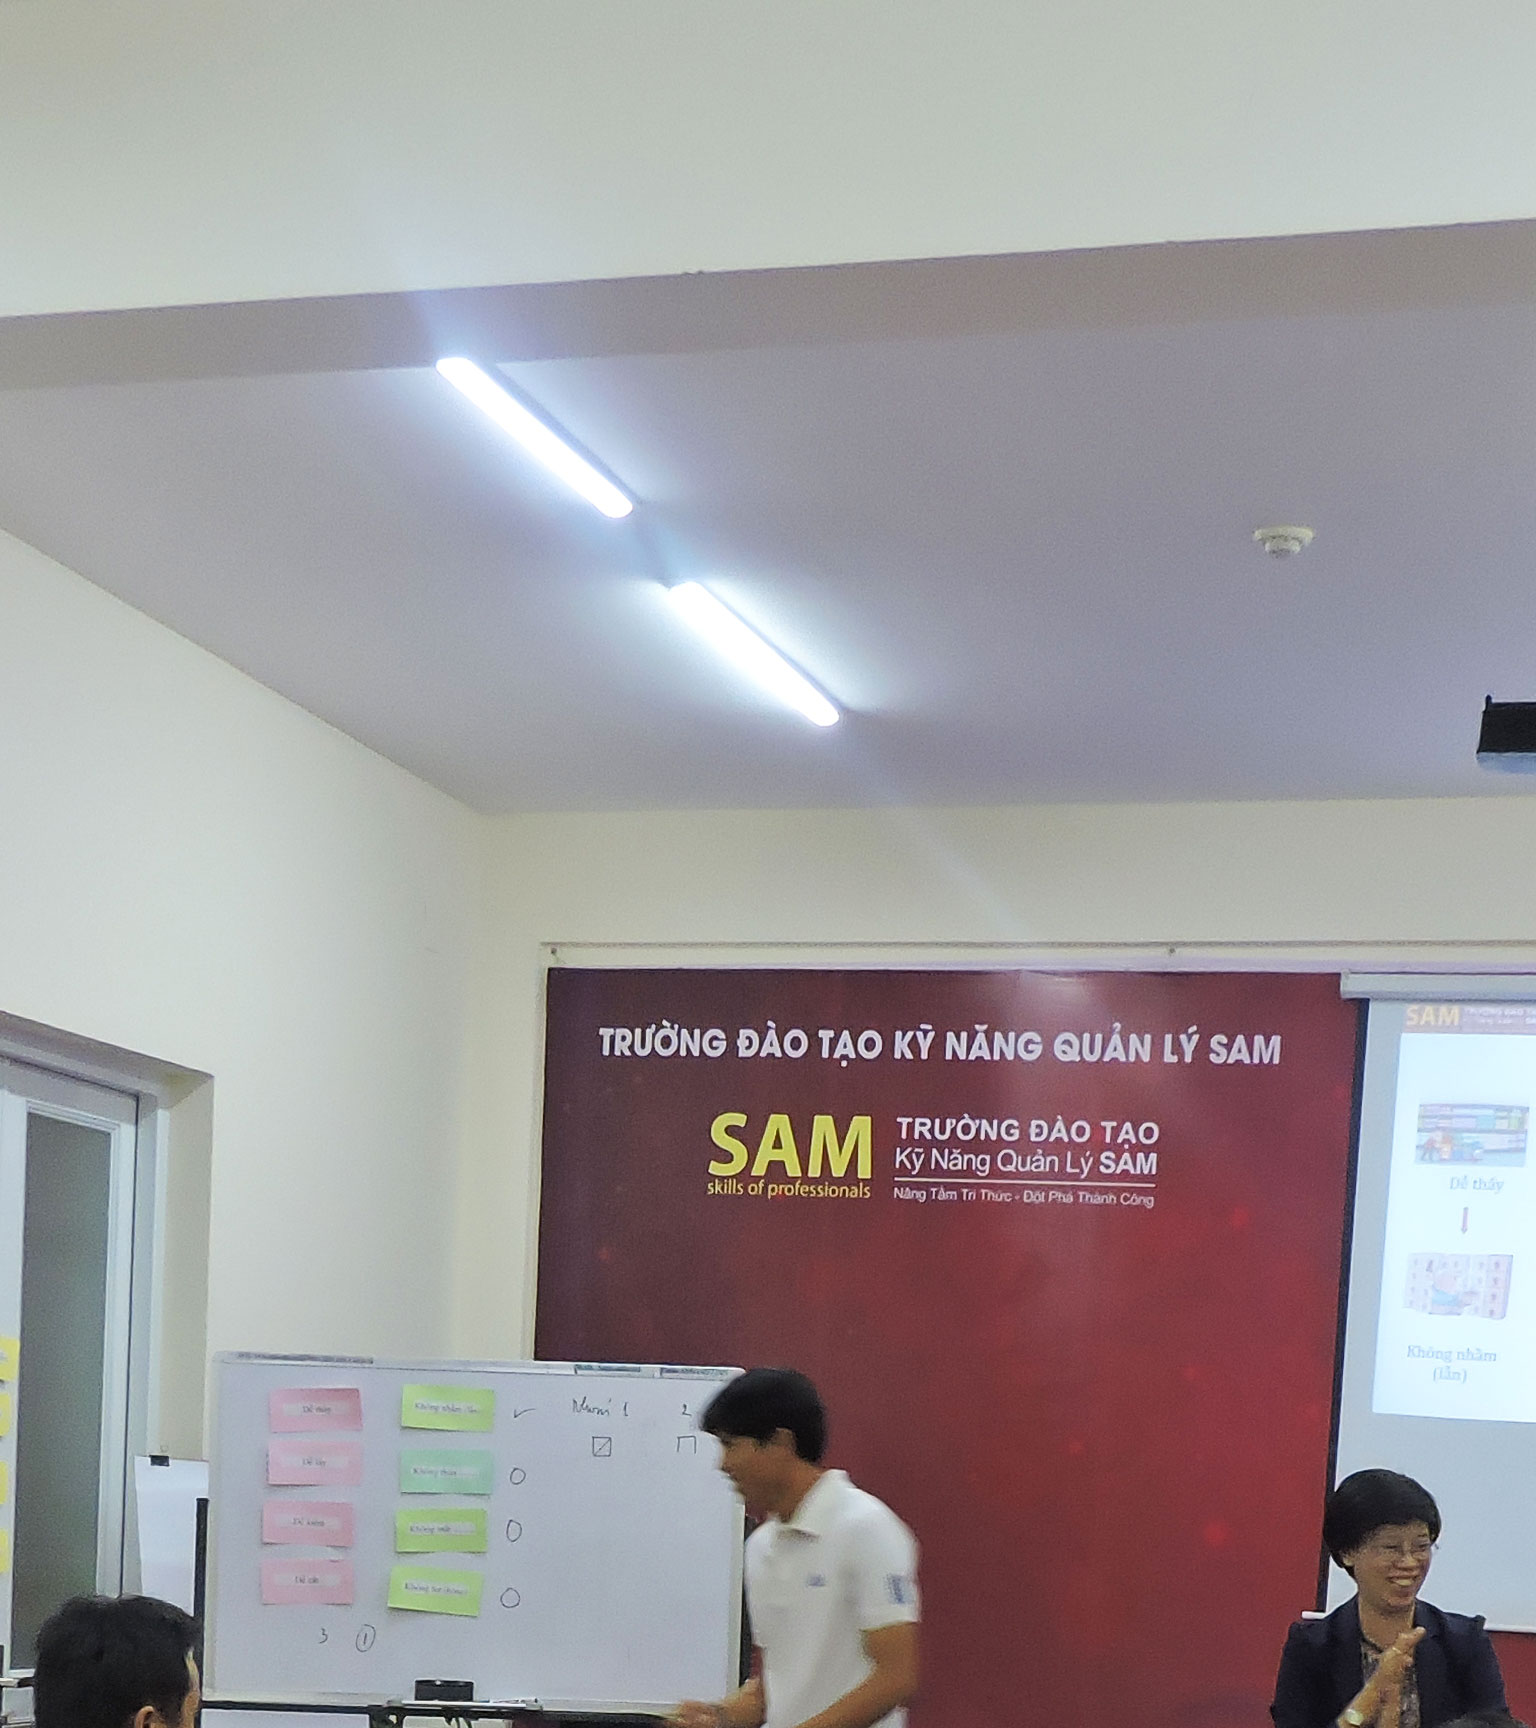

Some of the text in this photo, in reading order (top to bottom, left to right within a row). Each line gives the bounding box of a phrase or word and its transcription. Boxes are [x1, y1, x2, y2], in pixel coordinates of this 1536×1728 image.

[1406, 1004, 1461, 1026] SAM
[598, 1019, 1282, 1067] TRƯỜNG ĐÀO TẠO KỸ NĂNG QUẢN LÝ SAM
[707, 1112, 872, 1179] SAM
[896, 1113, 1160, 1149] TRƯỜNG ĐÀO TẠO
[895, 1146, 1158, 1178] Kỹ Năng Quản Lý SAM
[707, 1178, 872, 1199] skills of professionals
